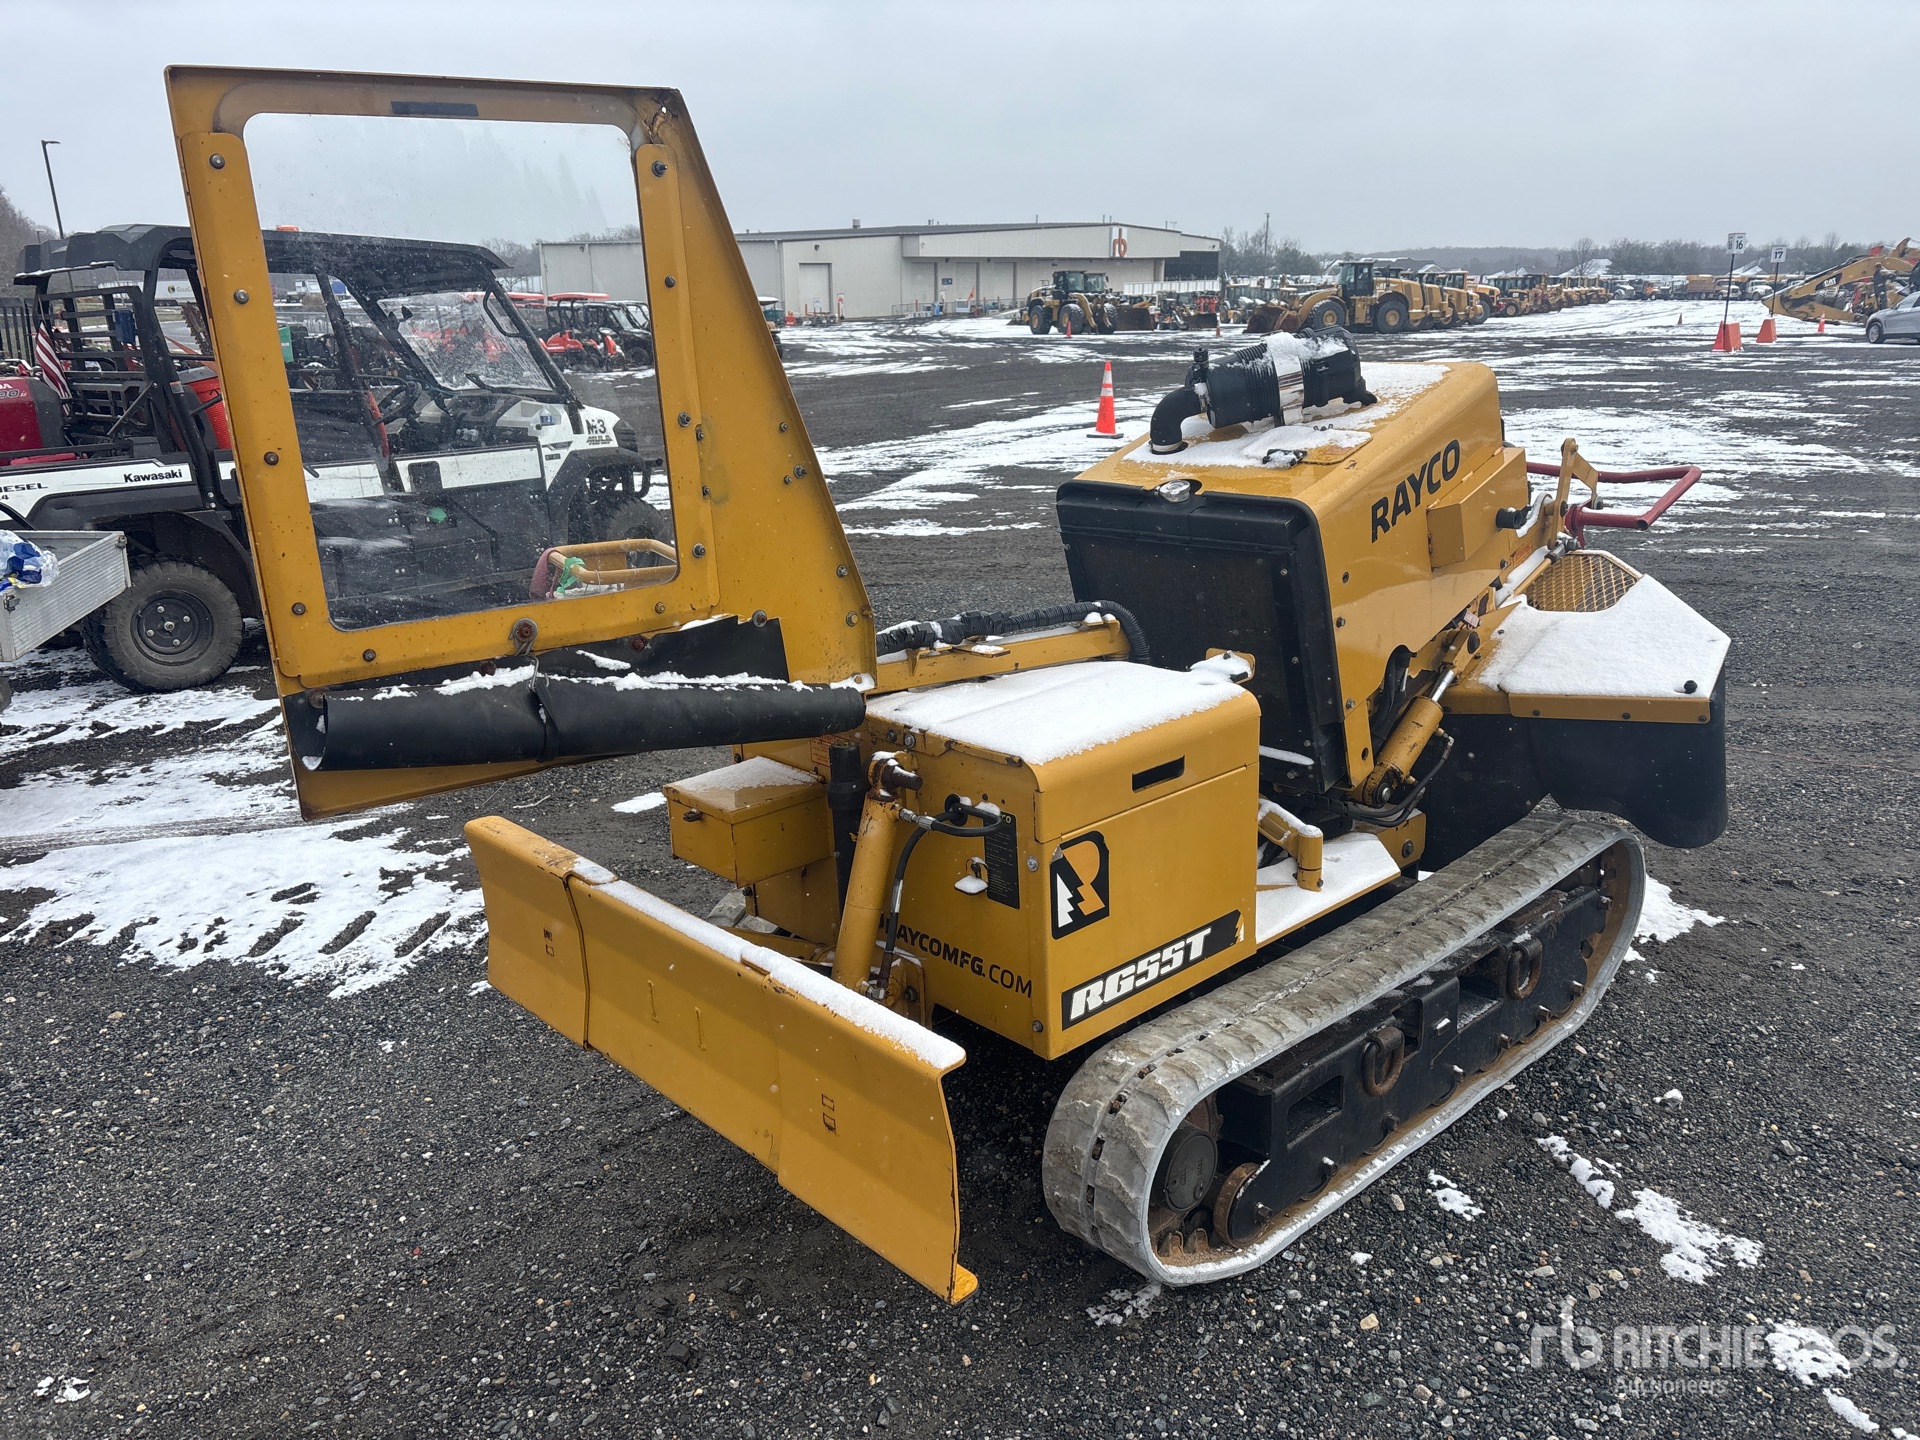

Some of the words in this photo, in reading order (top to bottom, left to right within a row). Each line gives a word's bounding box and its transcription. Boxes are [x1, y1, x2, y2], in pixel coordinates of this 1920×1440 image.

[1736, 240, 1744, 250] 16
[1774, 251, 1784, 260] 17
[1824, 277, 1837, 287] CAT
[124, 469, 183, 483] Kawasaki
[1371, 439, 1461, 544] RAYCO
[1070, 926, 1213, 1021] RG55T
